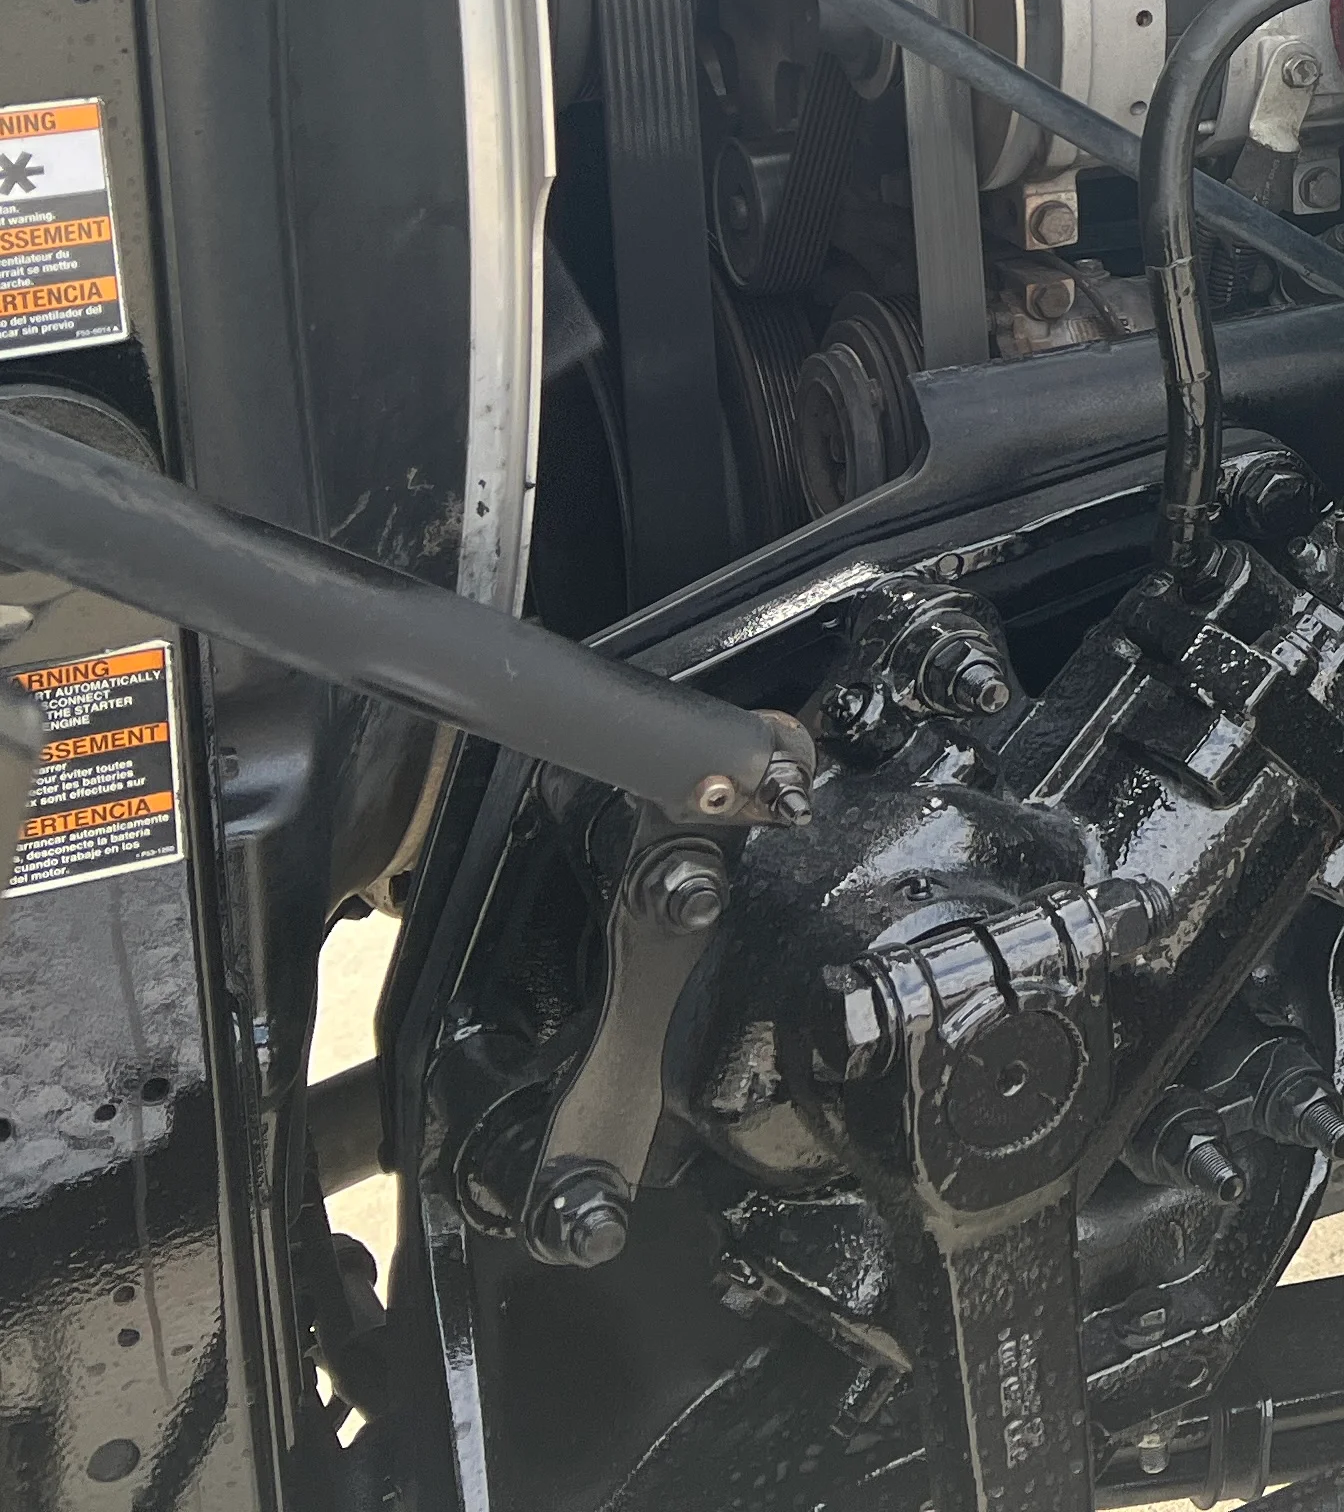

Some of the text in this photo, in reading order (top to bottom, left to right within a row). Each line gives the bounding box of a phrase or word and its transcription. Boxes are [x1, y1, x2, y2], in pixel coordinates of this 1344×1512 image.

[56, 249, 70, 259] du
[0, 281, 102, 312] RTENCIA
[11, 316, 26, 326] del
[30, 308, 83, 323] ventilador
[85, 305, 102, 316] del
[21, 324, 38, 335] sin
[41, 320, 74, 335] previo
[55, 671, 161, 697] AUTOMATICALLY
[46, 697, 132, 719] THE STARTER
[40, 794, 66, 806] sont
[126, 777, 145, 788] sur
[62, 780, 79, 791] les
[82, 770, 132, 787] batteries
[14, 859, 58, 873] cuando
[61, 849, 101, 865] trabaje
[105, 845, 118, 855] en
[122, 840, 140, 851] los
[27, 840, 93, 860] desconecte
[97, 835, 107, 845] la
